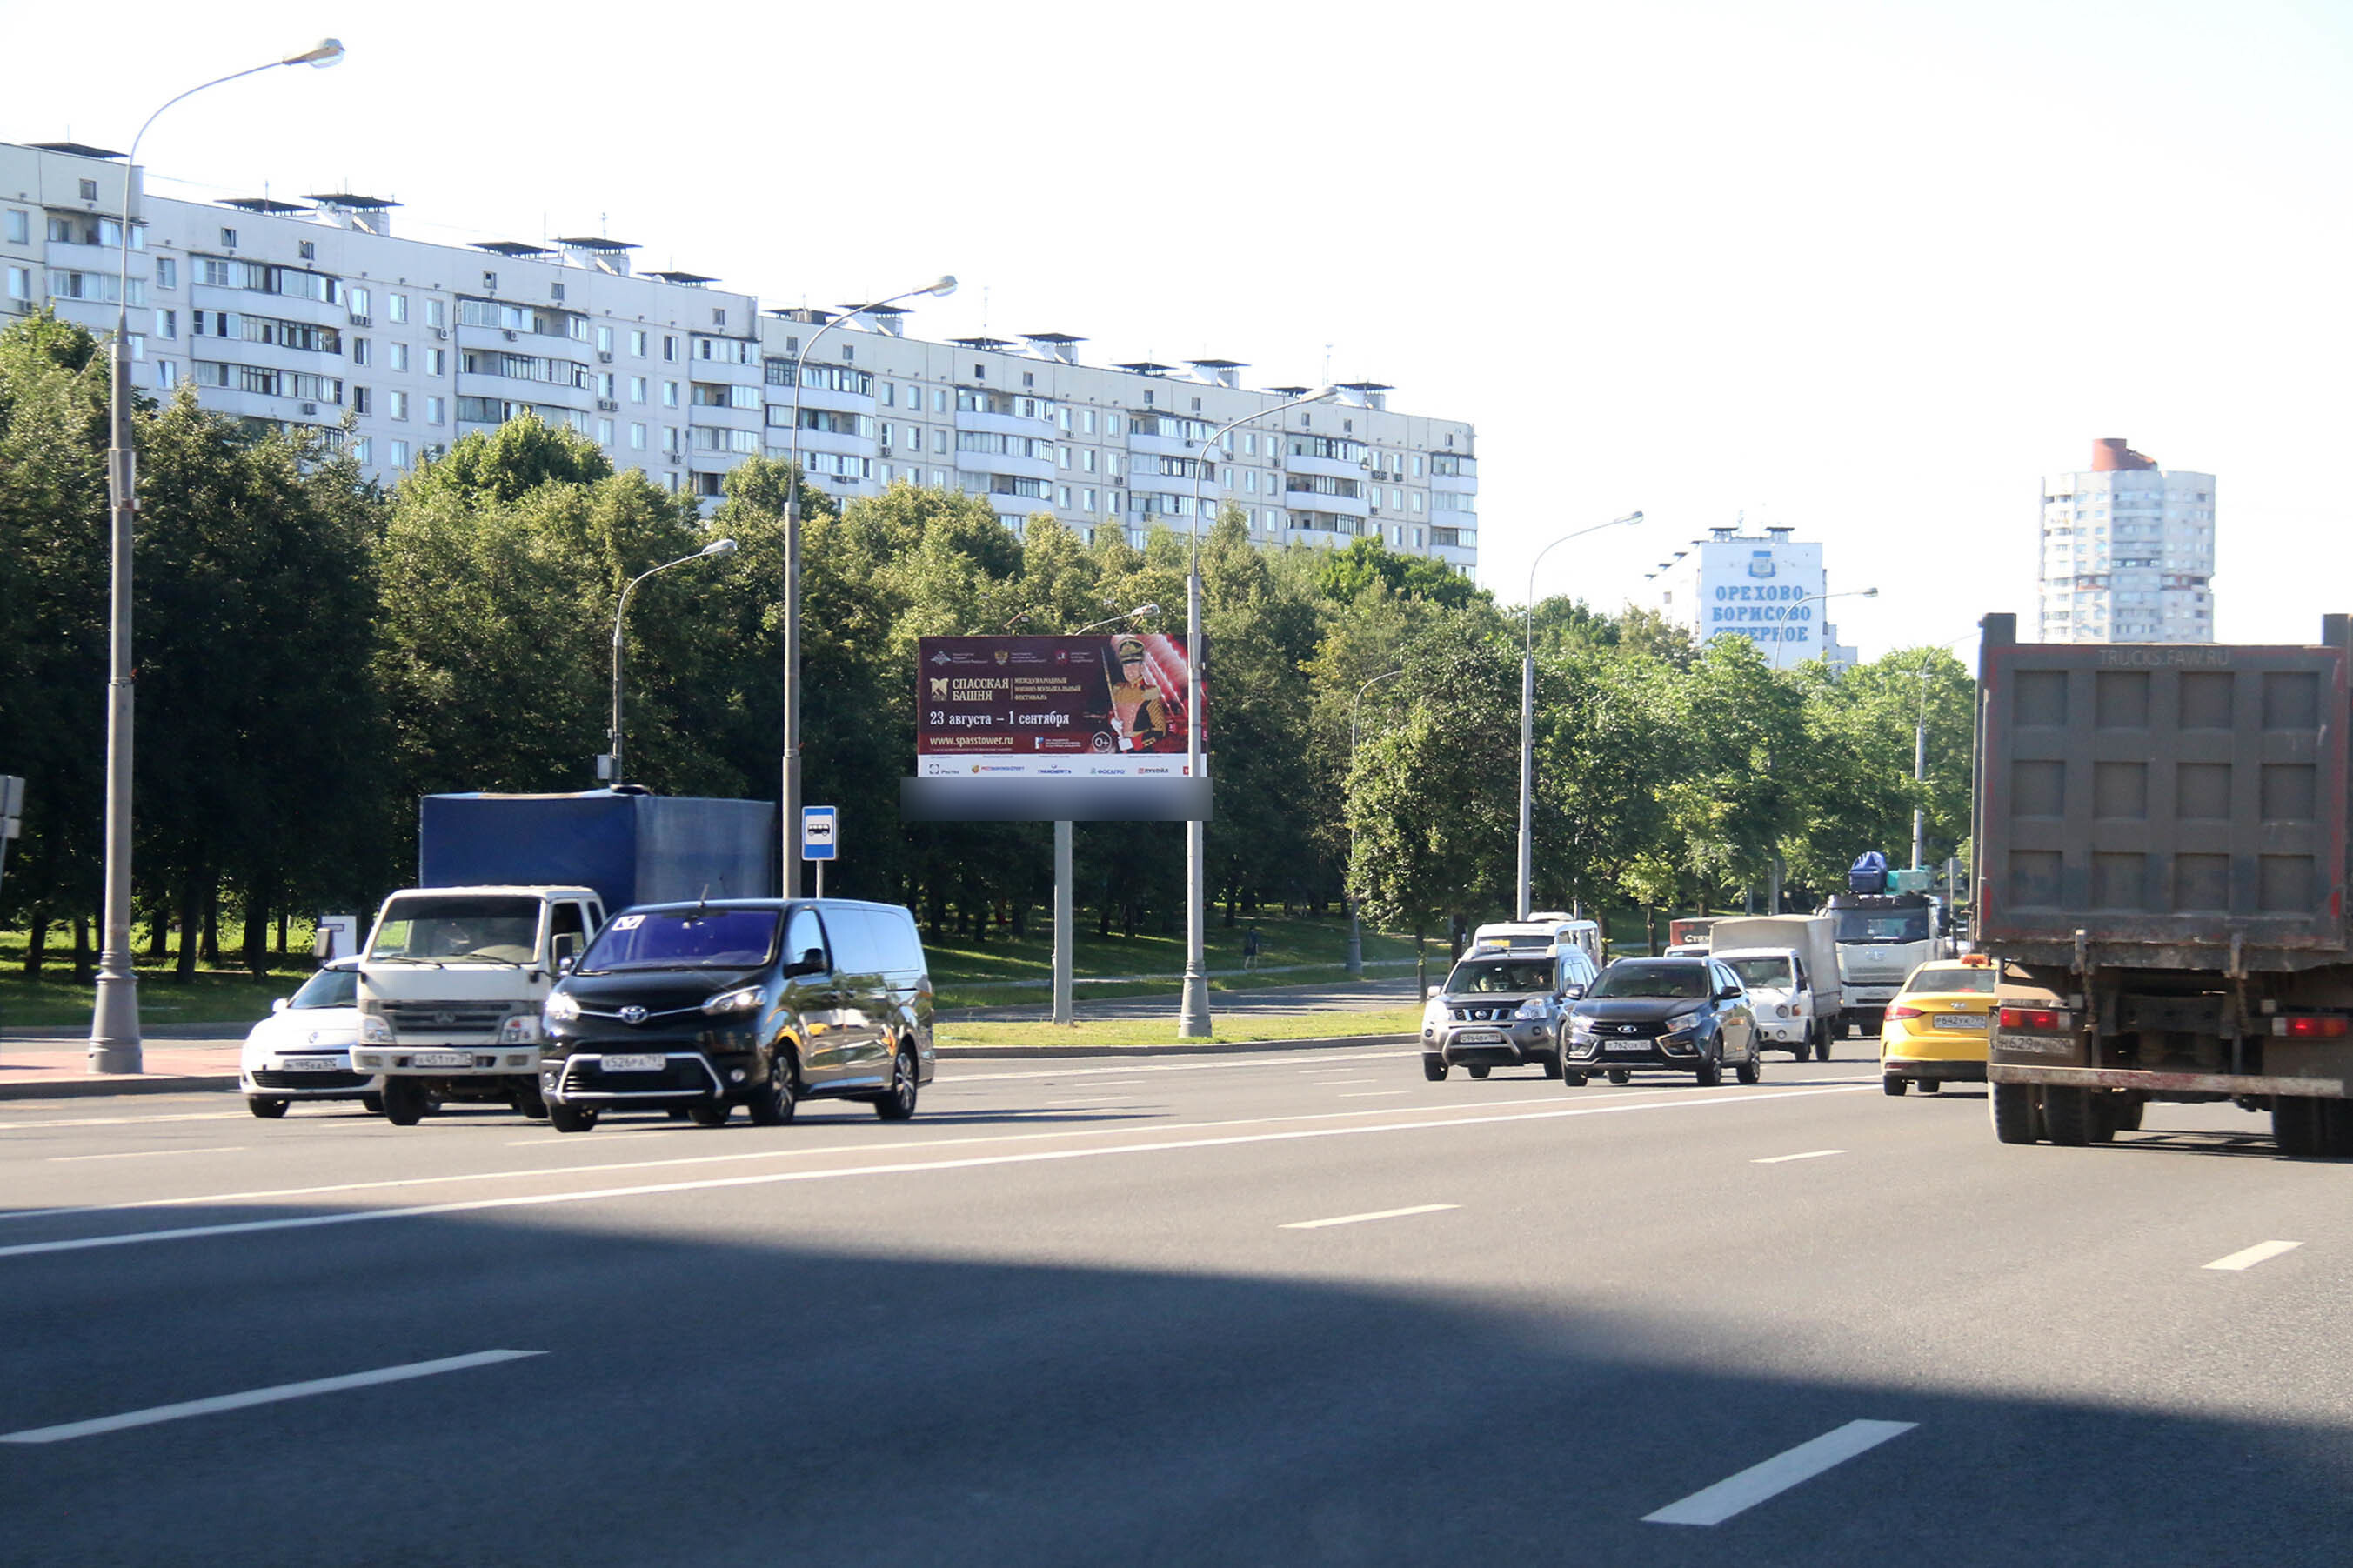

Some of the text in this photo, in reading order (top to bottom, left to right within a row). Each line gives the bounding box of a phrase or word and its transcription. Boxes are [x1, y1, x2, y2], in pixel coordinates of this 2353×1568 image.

[1715, 586, 1811, 602] ОРЕХОВО-
[1712, 606, 1811, 622] БОРИСОВО
[953, 677, 1009, 690] СПАССКАЯ
[953, 690, 993, 701] БАШНЯ
[930, 711, 945, 724] 23
[949, 714, 992, 728] августа
[1008, 711, 1014, 724] 1
[1019, 711, 1070, 727] сентября
[929, 736, 1013, 747] www.spasstower.ru
